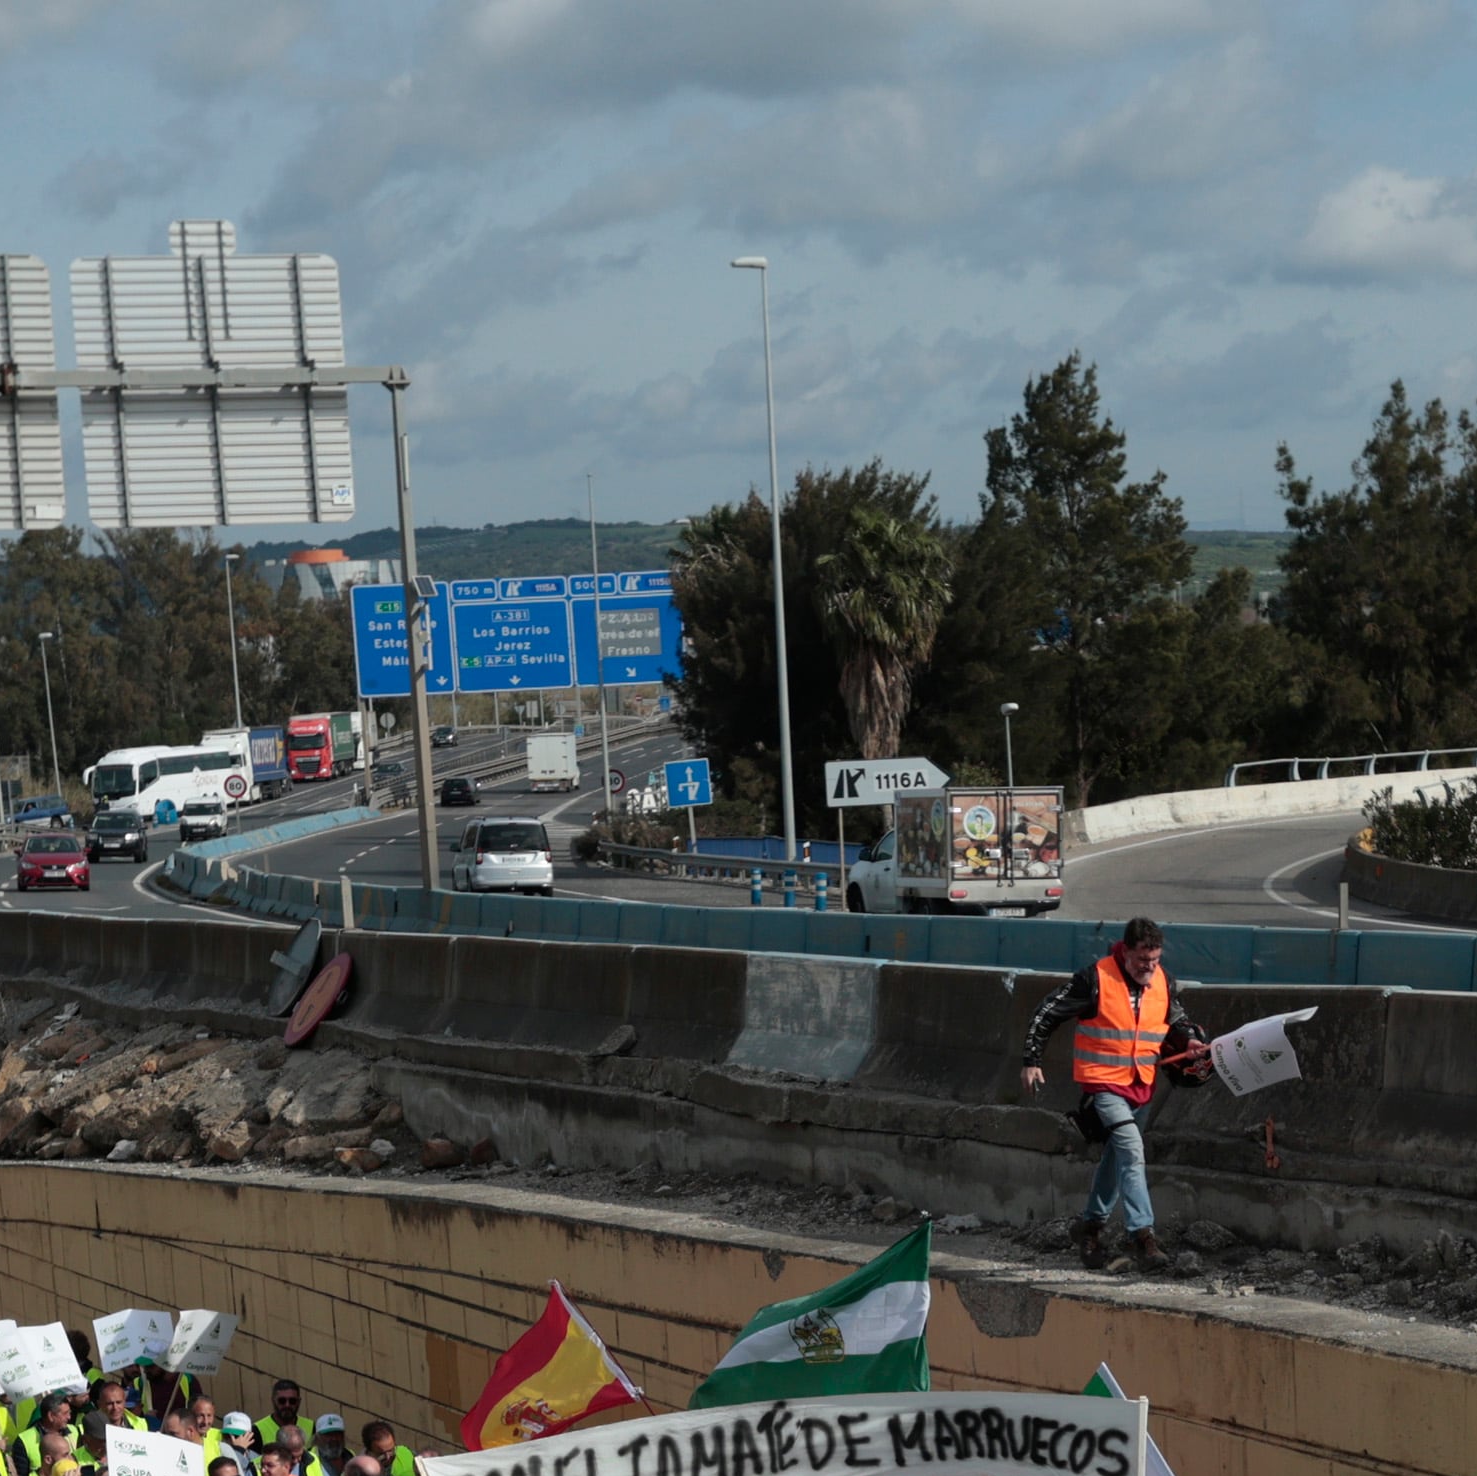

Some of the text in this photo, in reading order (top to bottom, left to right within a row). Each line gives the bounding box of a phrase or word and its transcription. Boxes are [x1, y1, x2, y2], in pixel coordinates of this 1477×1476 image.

[457, 586, 479, 595] 750
[575, 581, 596, 590] 500
[494, 611, 527, 621] A-381
[368, 620, 392, 632] San
[473, 625, 551, 638] Los Barrios
[494, 641, 531, 651] Jerez
[607, 646, 651, 657] Fresno
[487, 656, 514, 665] AP-4
[521, 654, 565, 665] Sevilla
[228, 782, 242, 791] 80
[1214, 1043, 1243, 1093] Campo Vivo
[799, 1411, 880, 1472] DE
